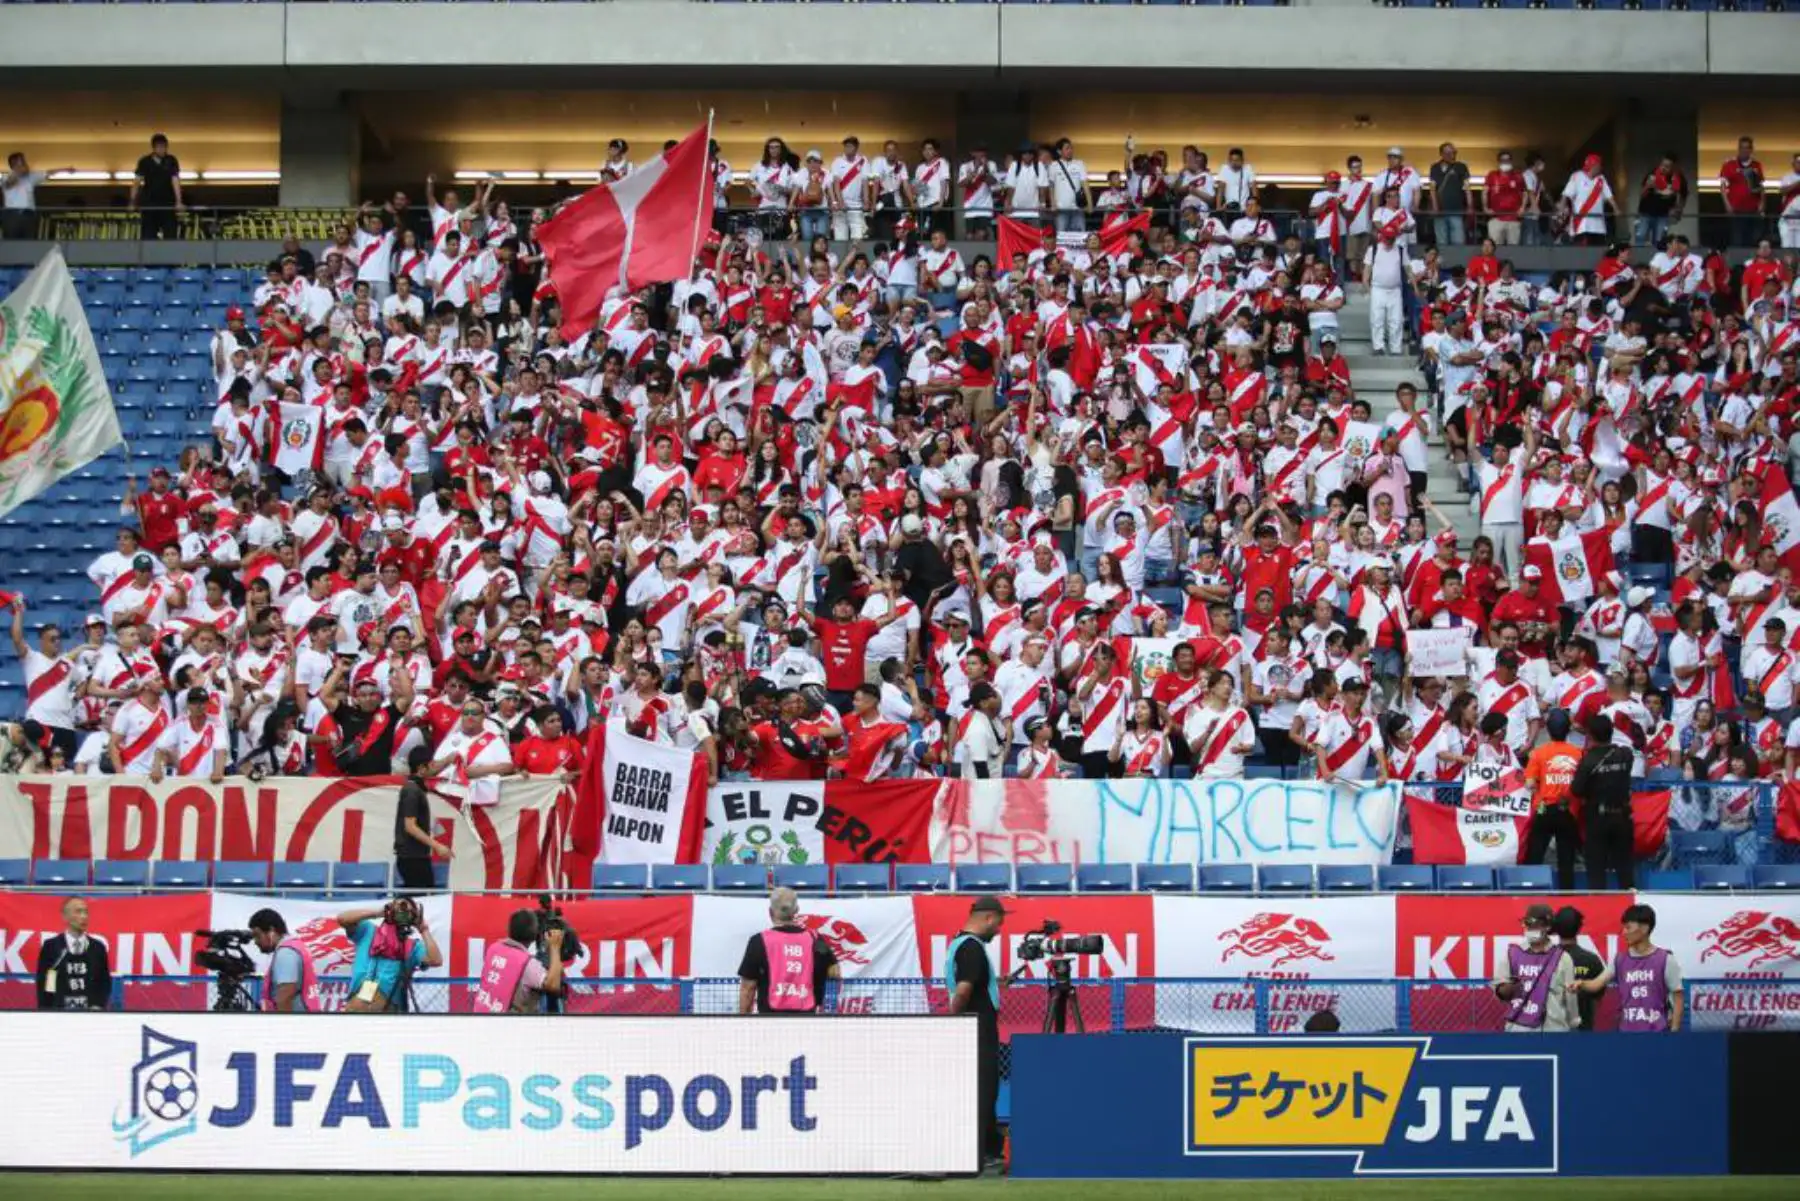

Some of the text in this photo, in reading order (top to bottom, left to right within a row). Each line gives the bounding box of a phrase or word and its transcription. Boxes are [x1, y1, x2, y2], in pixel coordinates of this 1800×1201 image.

[616, 762, 672, 792] BARRA
[1469, 764, 1503, 779] HOY
[612, 783, 668, 813] BRAVA
[721, 790, 770, 821] EL
[1466, 793, 1530, 811] CUMPLE
[1094, 780, 1398, 864] MARCELO
[1519, 964, 1543, 977] NR
[1209, 1071, 1389, 1120] チケット
[1404, 1086, 1536, 1142] JFA
